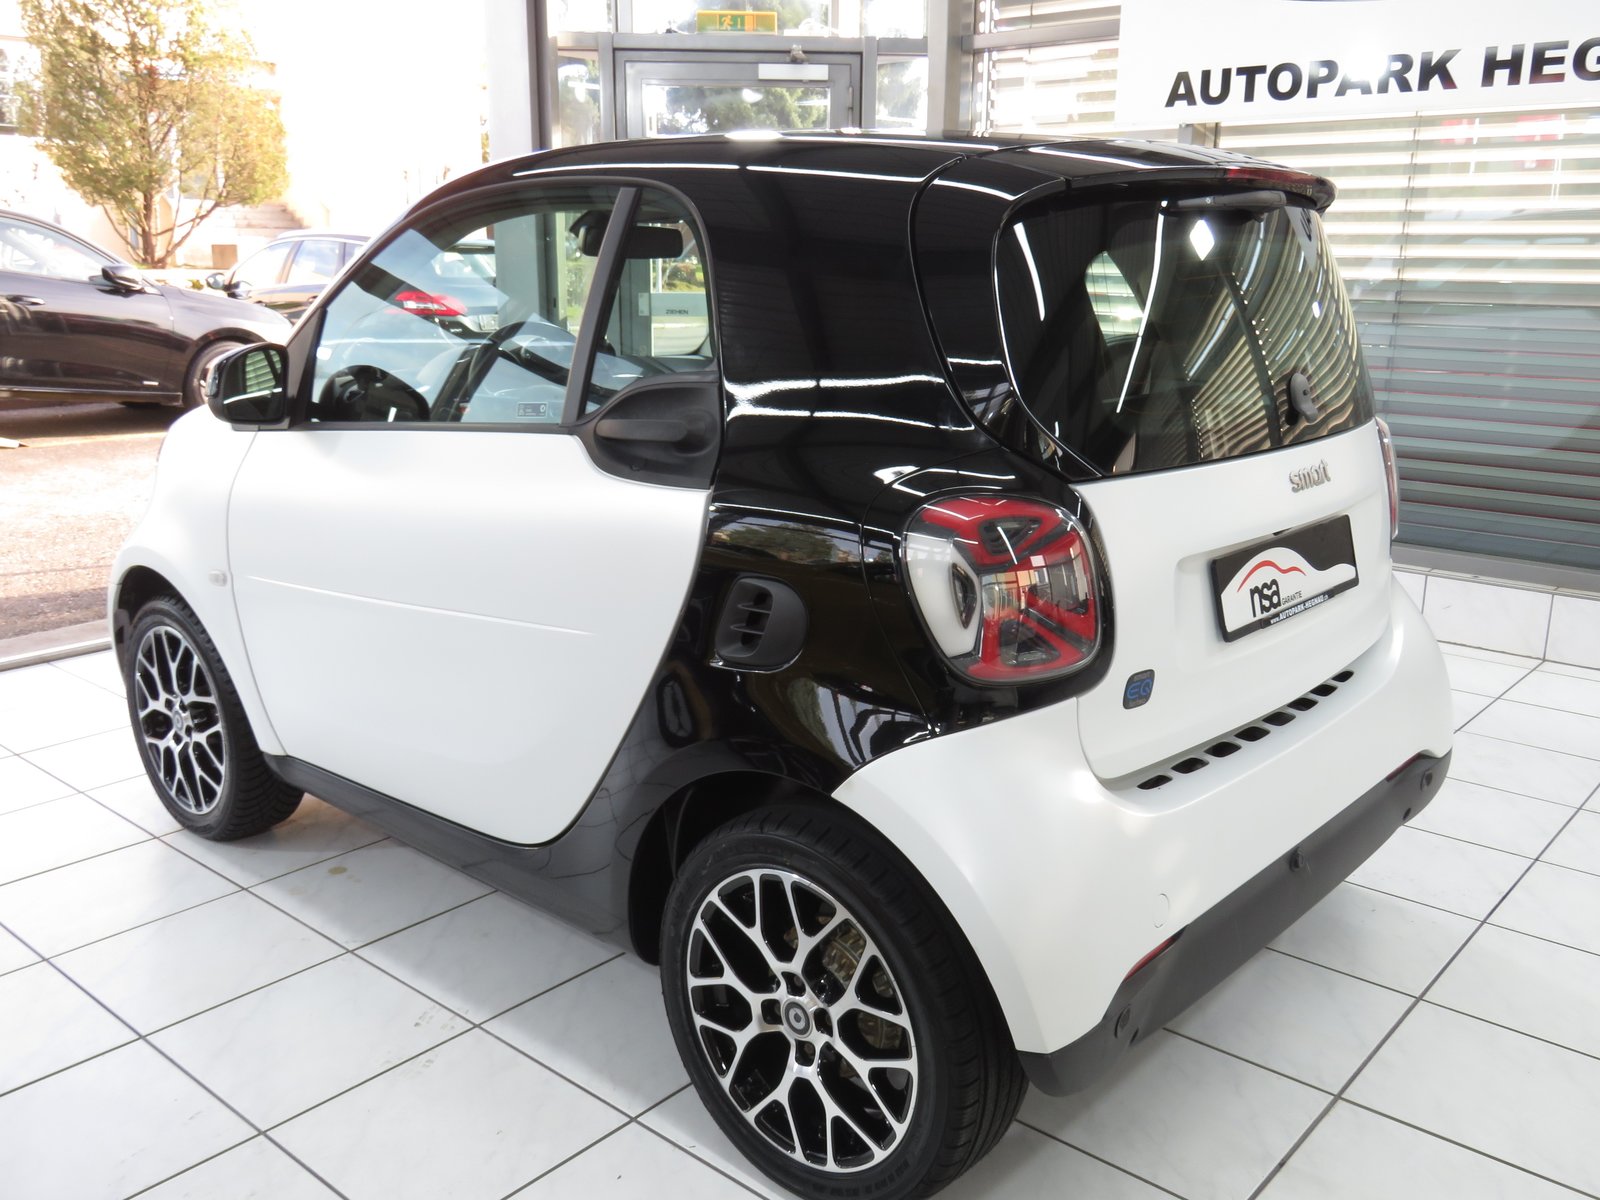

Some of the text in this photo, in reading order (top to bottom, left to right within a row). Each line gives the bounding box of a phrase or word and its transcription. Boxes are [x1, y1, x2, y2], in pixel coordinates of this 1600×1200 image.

[1165, 49, 1462, 107] AUTOPARK
[1289, 459, 1331, 493] smart
[1250, 579, 1281, 617] nsa
[1282, 590, 1303, 605] GARANTIE
[1127, 678, 1152, 699] EQ
